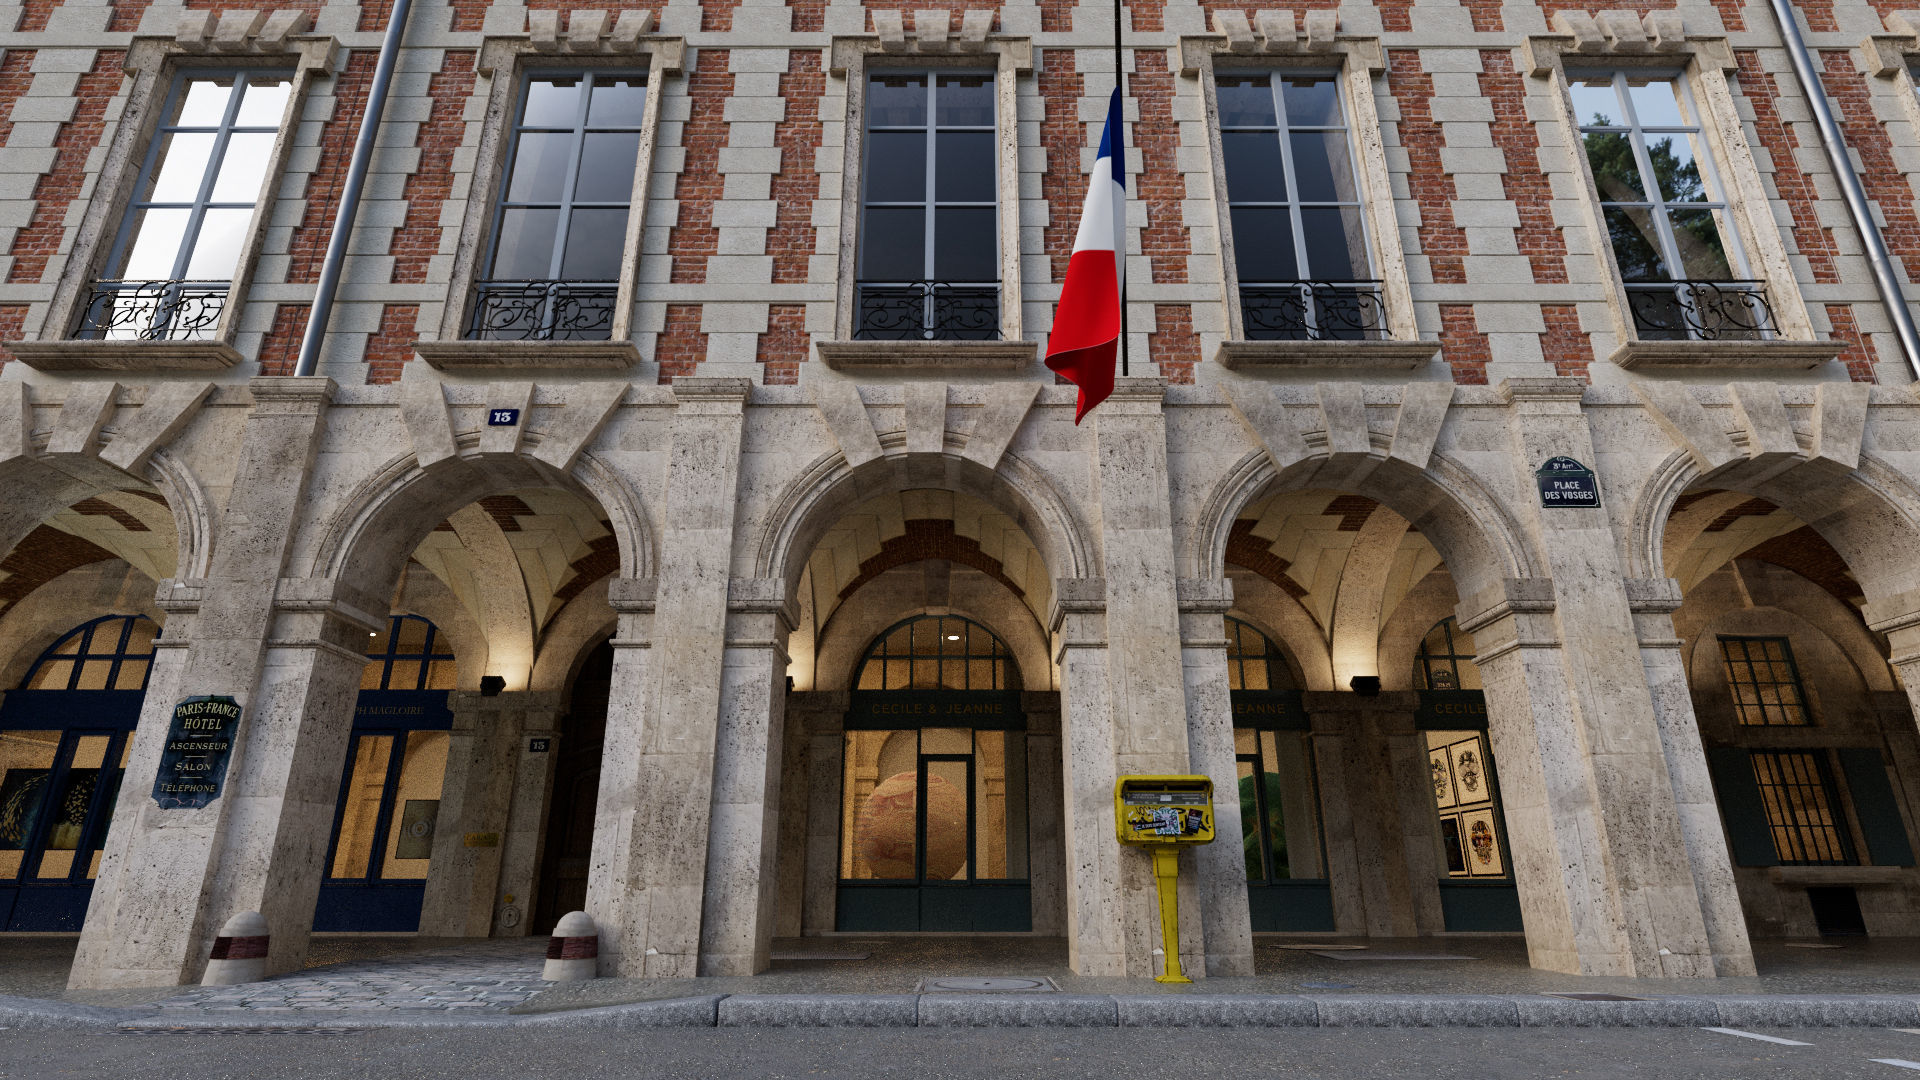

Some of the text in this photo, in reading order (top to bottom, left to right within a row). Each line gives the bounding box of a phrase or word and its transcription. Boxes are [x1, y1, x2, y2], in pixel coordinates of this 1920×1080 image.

[1554, 481, 1580, 490] PLACE
[1544, 491, 1594, 500] DES VOSGES
[176, 702, 240, 719] PARIS-FRANCE
[928, 703, 936, 714] &
[944, 703, 1003, 714] JEANNE
[184, 716, 222, 730] HÔTEL
[169, 741, 228, 750] ASCENSEUR
[174, 762, 212, 771] SALON
[160, 782, 216, 793] TÉLÉPHONE
